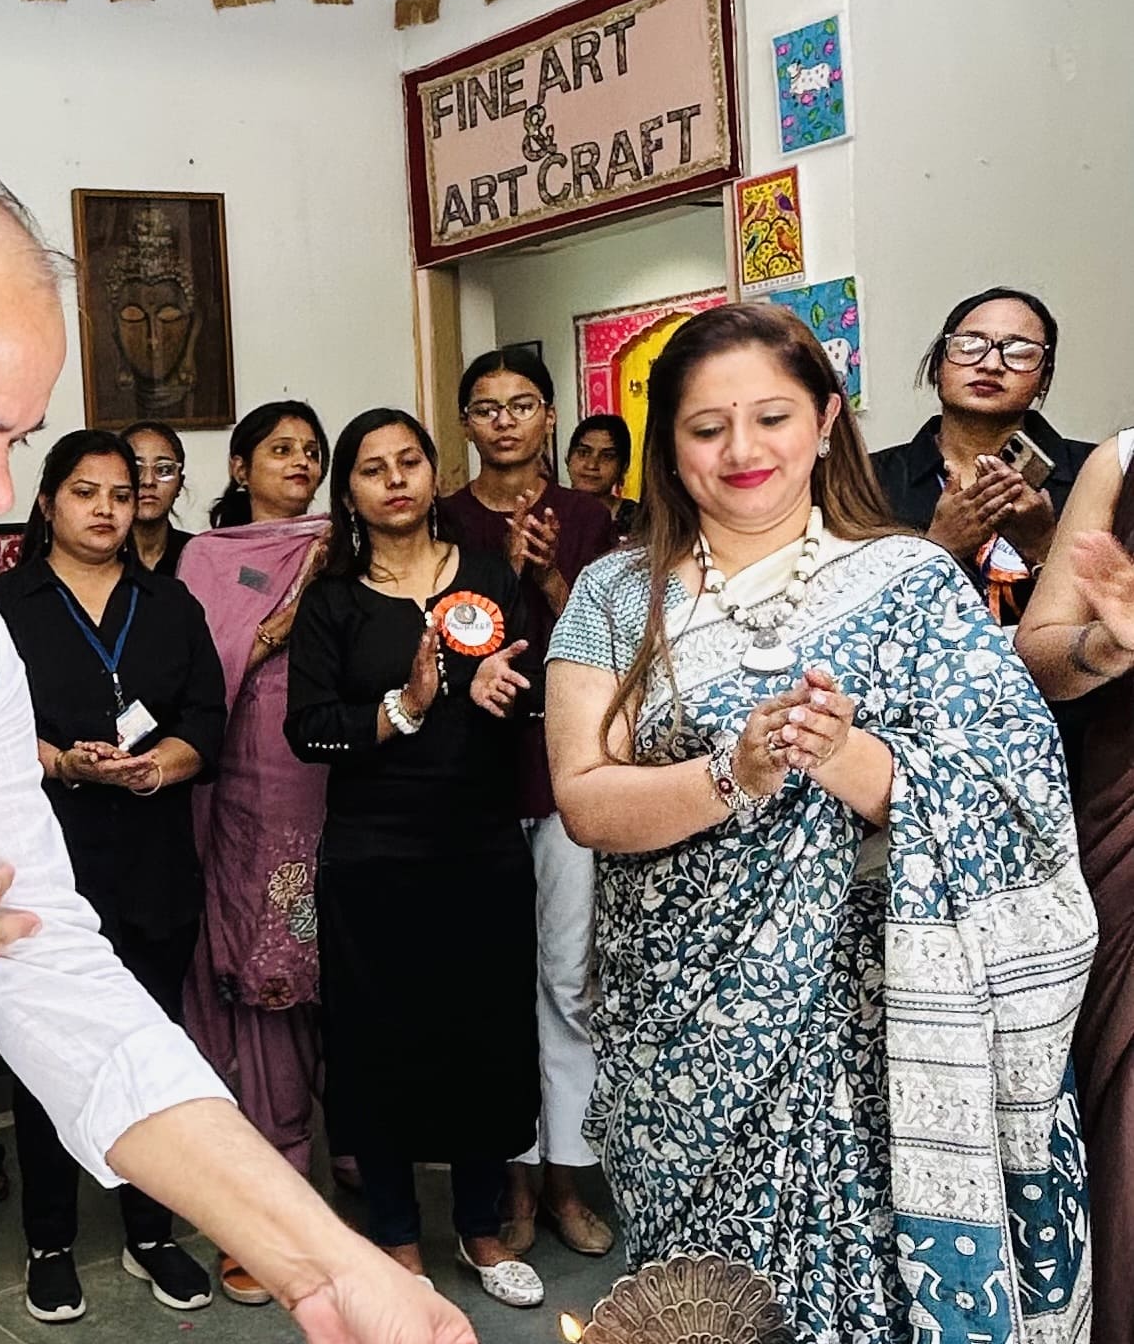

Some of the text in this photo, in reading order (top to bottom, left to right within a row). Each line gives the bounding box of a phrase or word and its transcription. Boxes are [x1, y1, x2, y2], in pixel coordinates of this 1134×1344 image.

[430, 15, 636, 139] FINE ART
[522, 103, 558, 162] &
[439, 104, 702, 235] ART CRAFT
